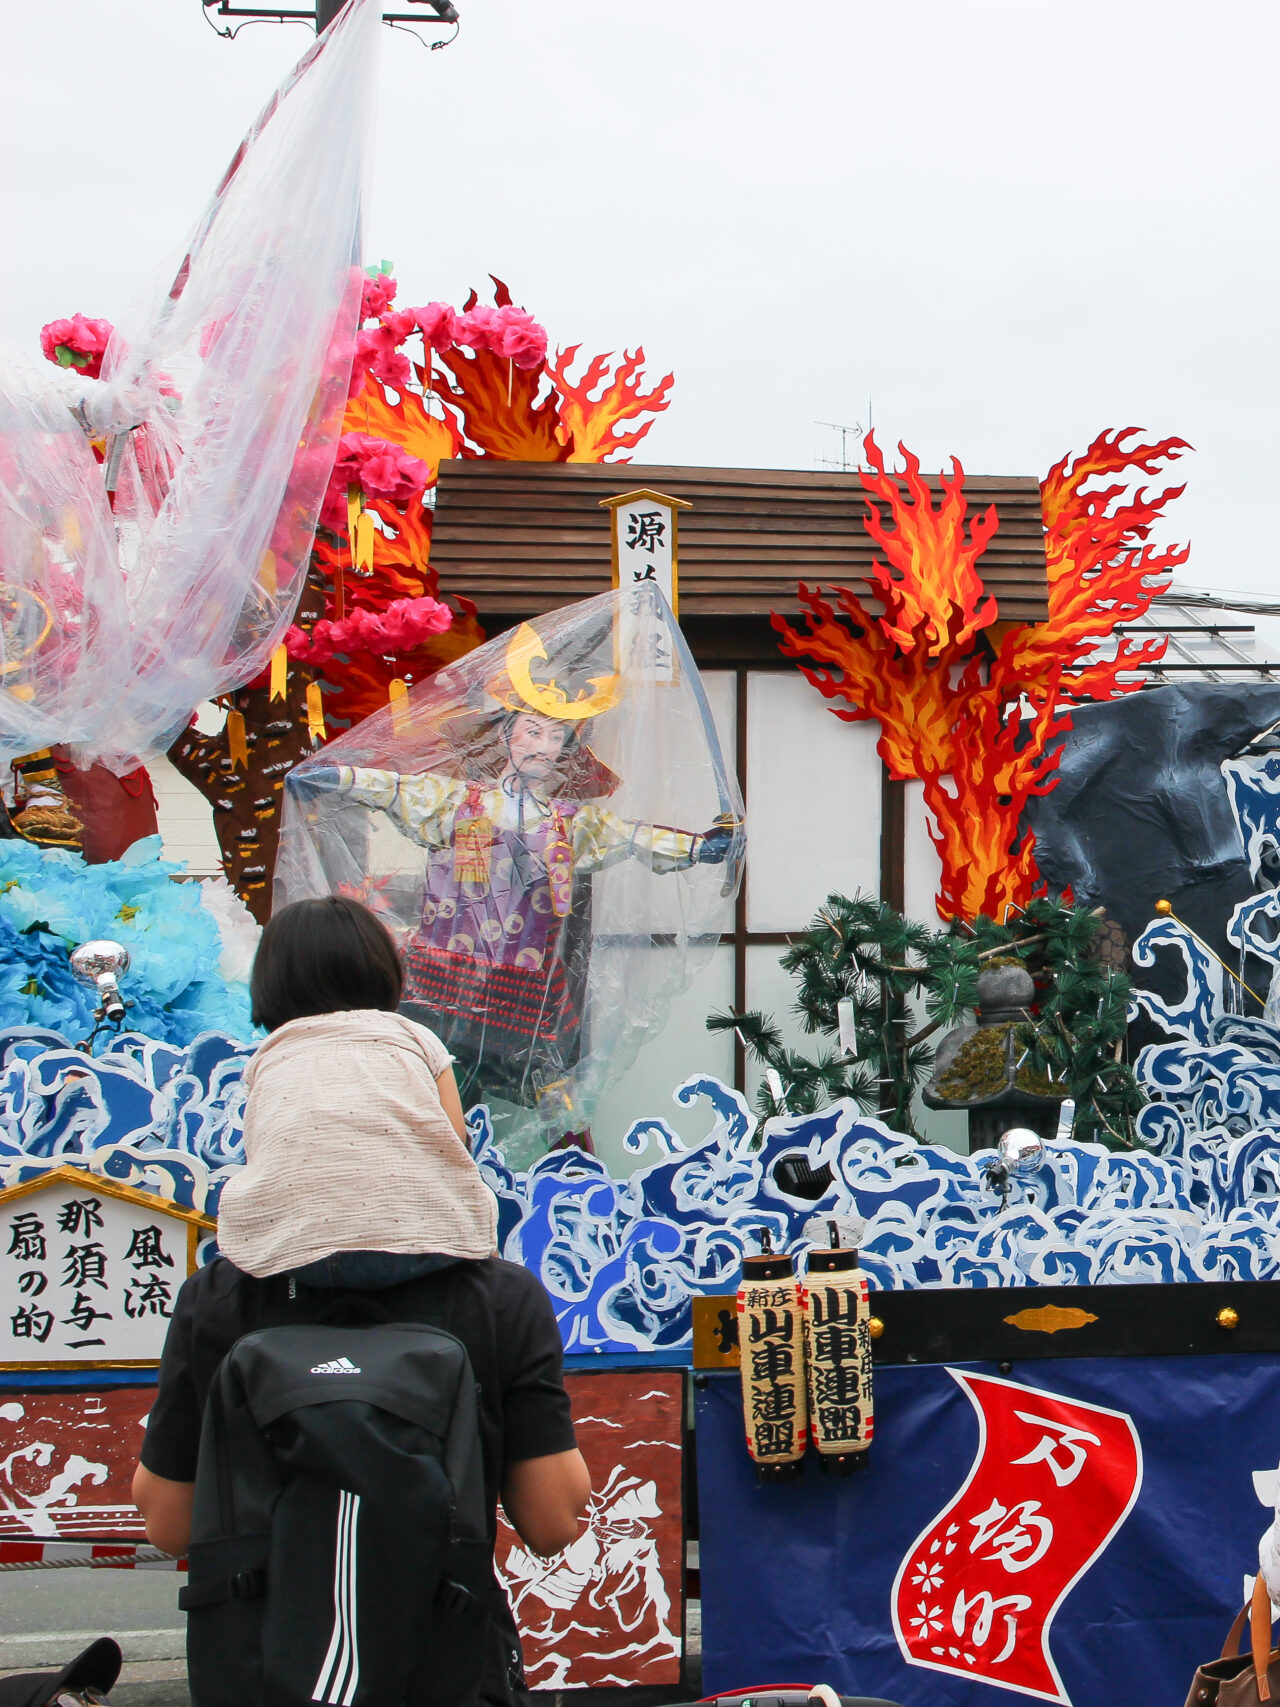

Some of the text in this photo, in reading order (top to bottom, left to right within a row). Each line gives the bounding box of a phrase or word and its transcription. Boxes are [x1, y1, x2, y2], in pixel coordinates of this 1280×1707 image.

[6, 1211, 55, 1343] 扇の的
[56, 1197, 113, 1349] 那須与一
[121, 1224, 175, 1319] 風流
[748, 1308, 797, 1457] 山車連盟
[811, 1286, 862, 1441] 山車連盟
[952, 1410, 1101, 1664] 万場町
